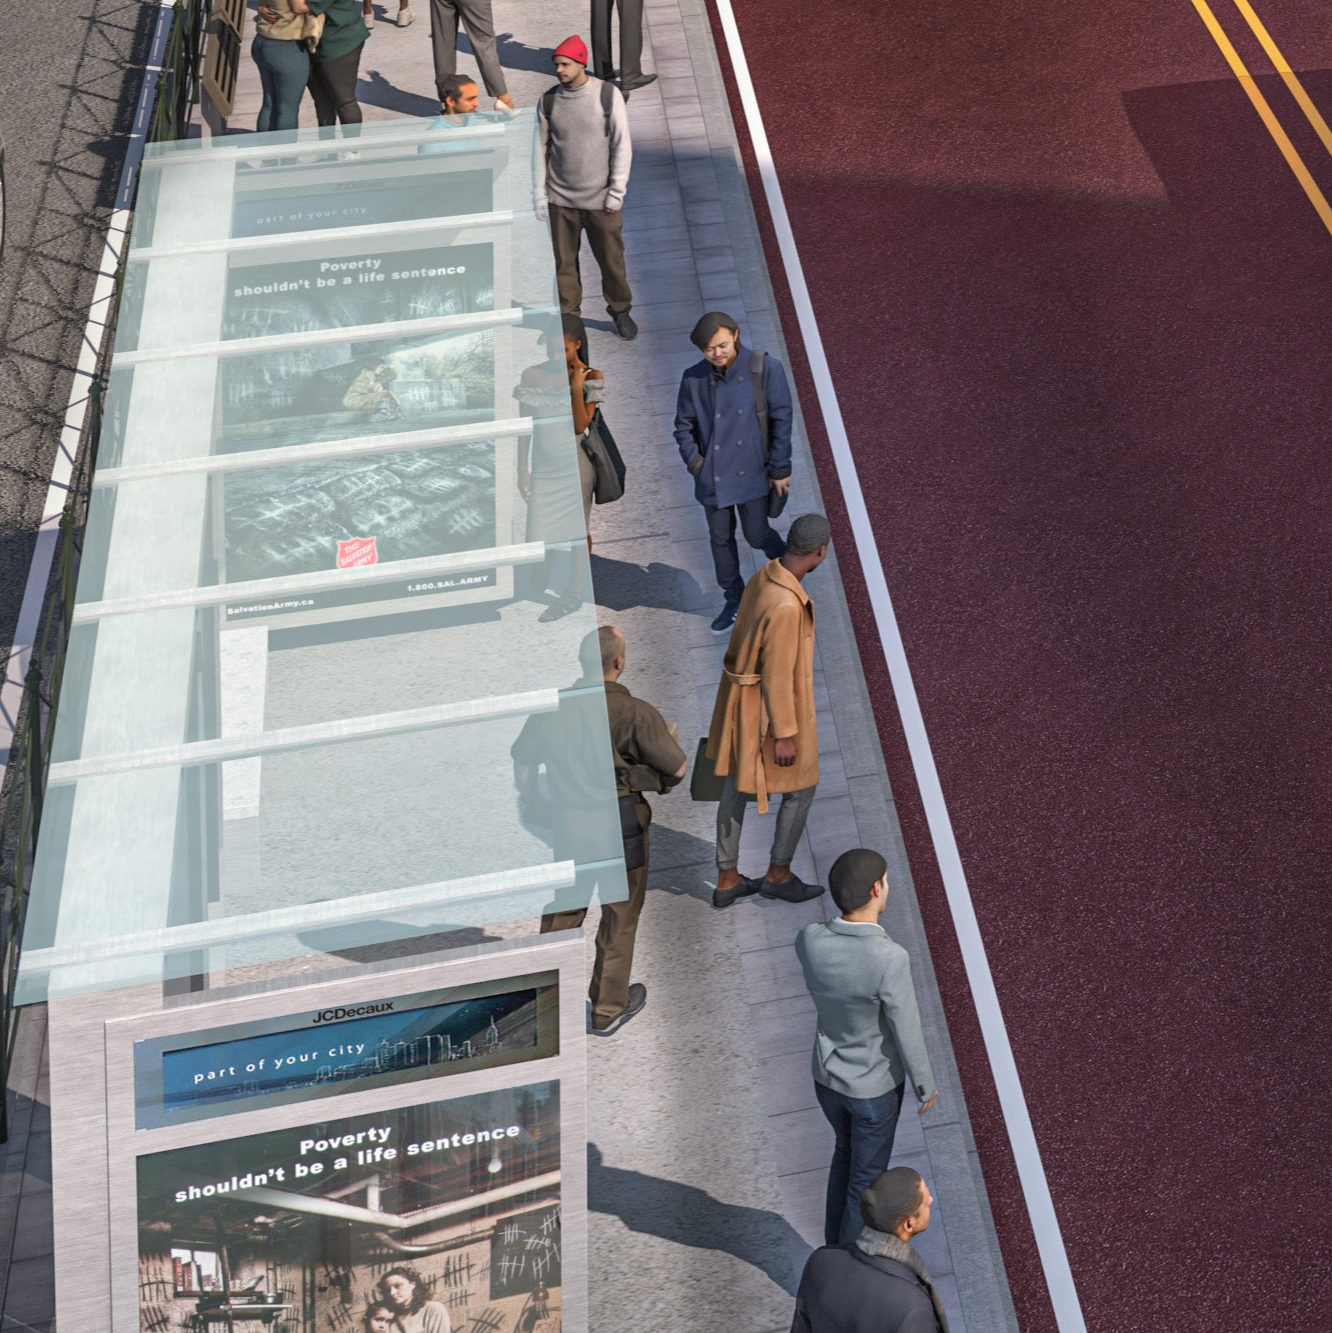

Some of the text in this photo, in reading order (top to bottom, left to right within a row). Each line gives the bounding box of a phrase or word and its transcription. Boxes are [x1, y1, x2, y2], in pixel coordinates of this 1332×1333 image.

[256, 205, 367, 225] part of your city
[320, 258, 382, 273] Poverty
[234, 264, 466, 298] shouldn't be a life sentence
[339, 544, 373, 566] SALVATION
[345, 542, 360, 554] THE
[407, 575, 488, 592] 1.800.SAL.ARMY
[227, 598, 314, 614] SalvationArmy.ca
[312, 1001, 394, 1024] JCDecaux
[194, 1042, 365, 1084] part of your city
[300, 1124, 391, 1155] Poverty
[175, 1124, 520, 1203] shouldn't be a life sentence
